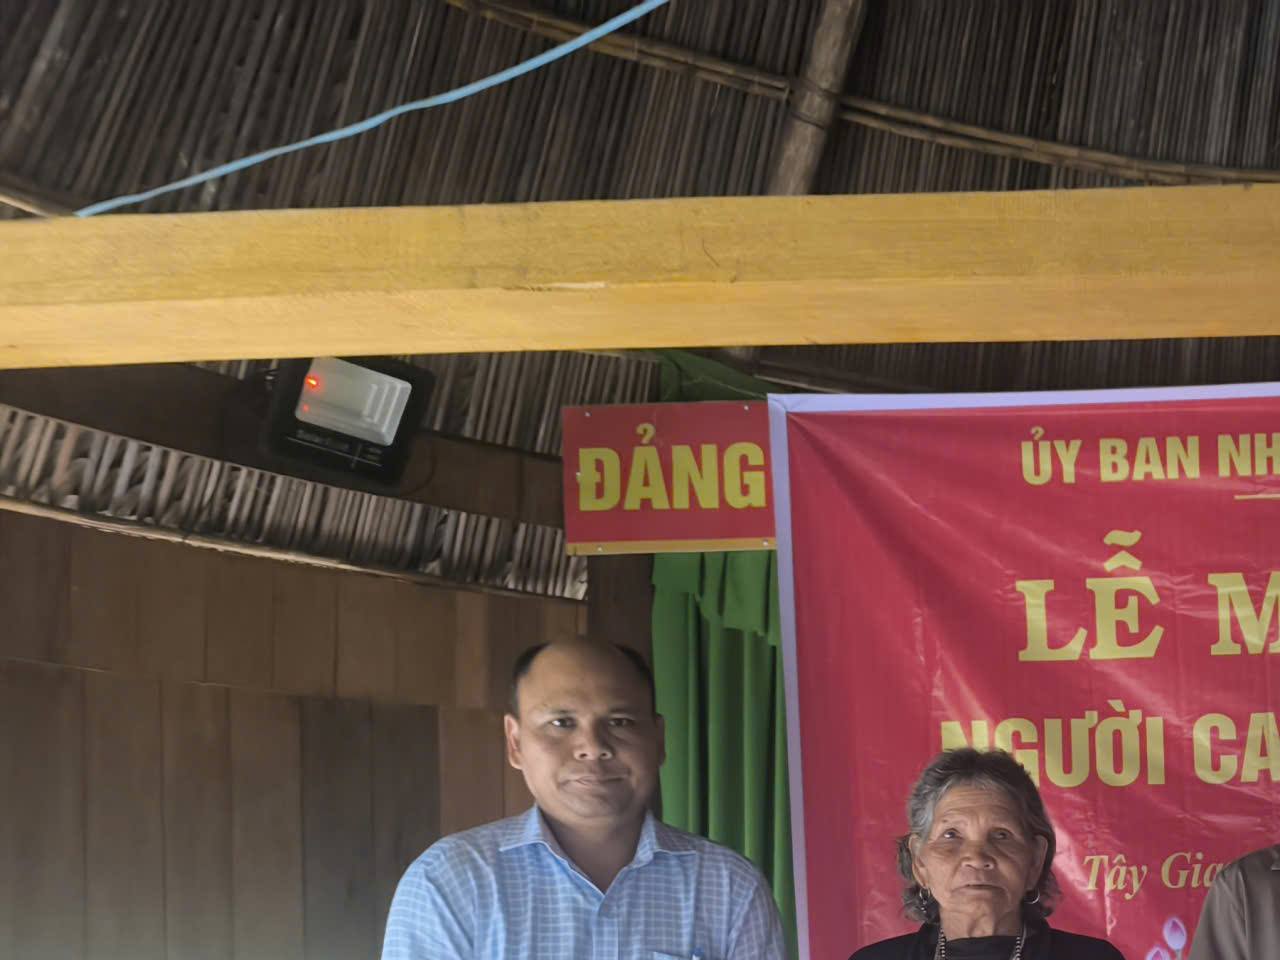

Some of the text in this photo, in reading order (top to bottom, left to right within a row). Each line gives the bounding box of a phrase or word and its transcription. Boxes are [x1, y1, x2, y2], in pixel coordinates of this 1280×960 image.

[577, 424, 767, 513] ĐẢNG
[1020, 427, 1083, 485] ỦY
[1099, 434, 1200, 483] BAN
[1016, 530, 1165, 662] LỄ
[1083, 852, 1227, 900] Tây Gia
